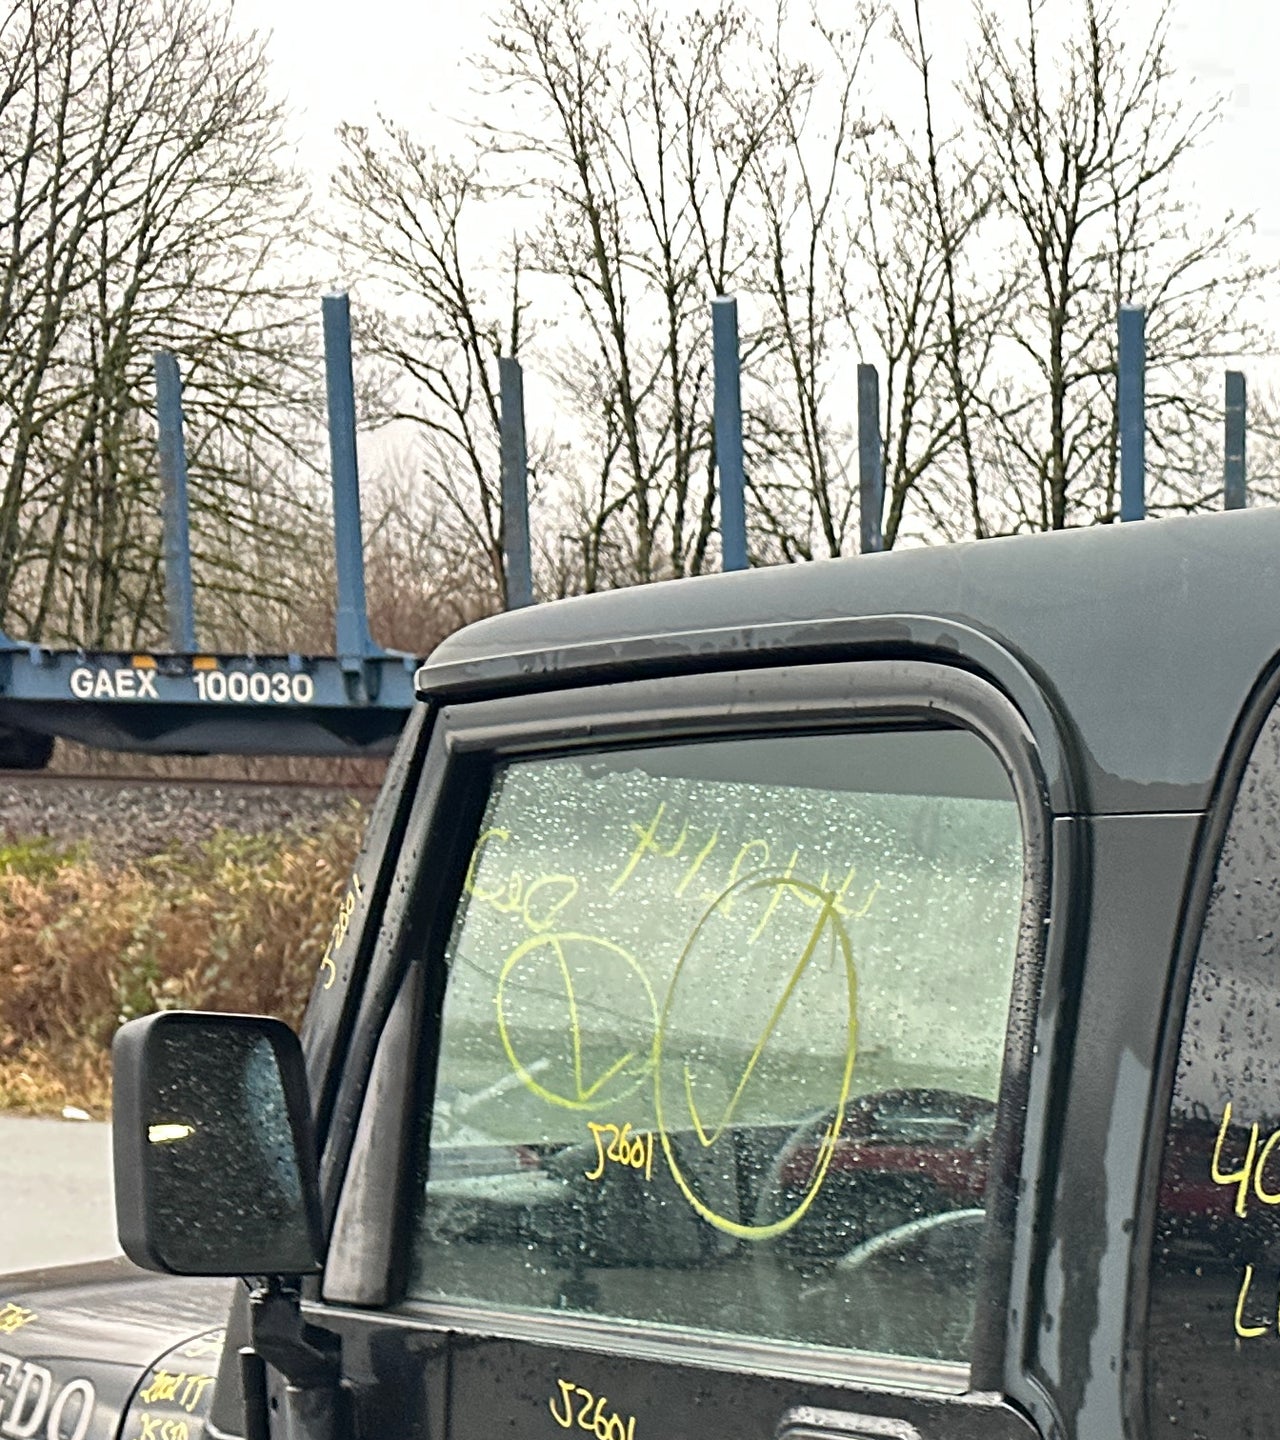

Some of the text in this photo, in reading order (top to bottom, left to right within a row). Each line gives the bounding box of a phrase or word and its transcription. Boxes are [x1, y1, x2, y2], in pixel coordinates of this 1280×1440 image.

[70, 668, 313, 702] GAEX 100030
[584, 1121, 654, 1181] J2601
